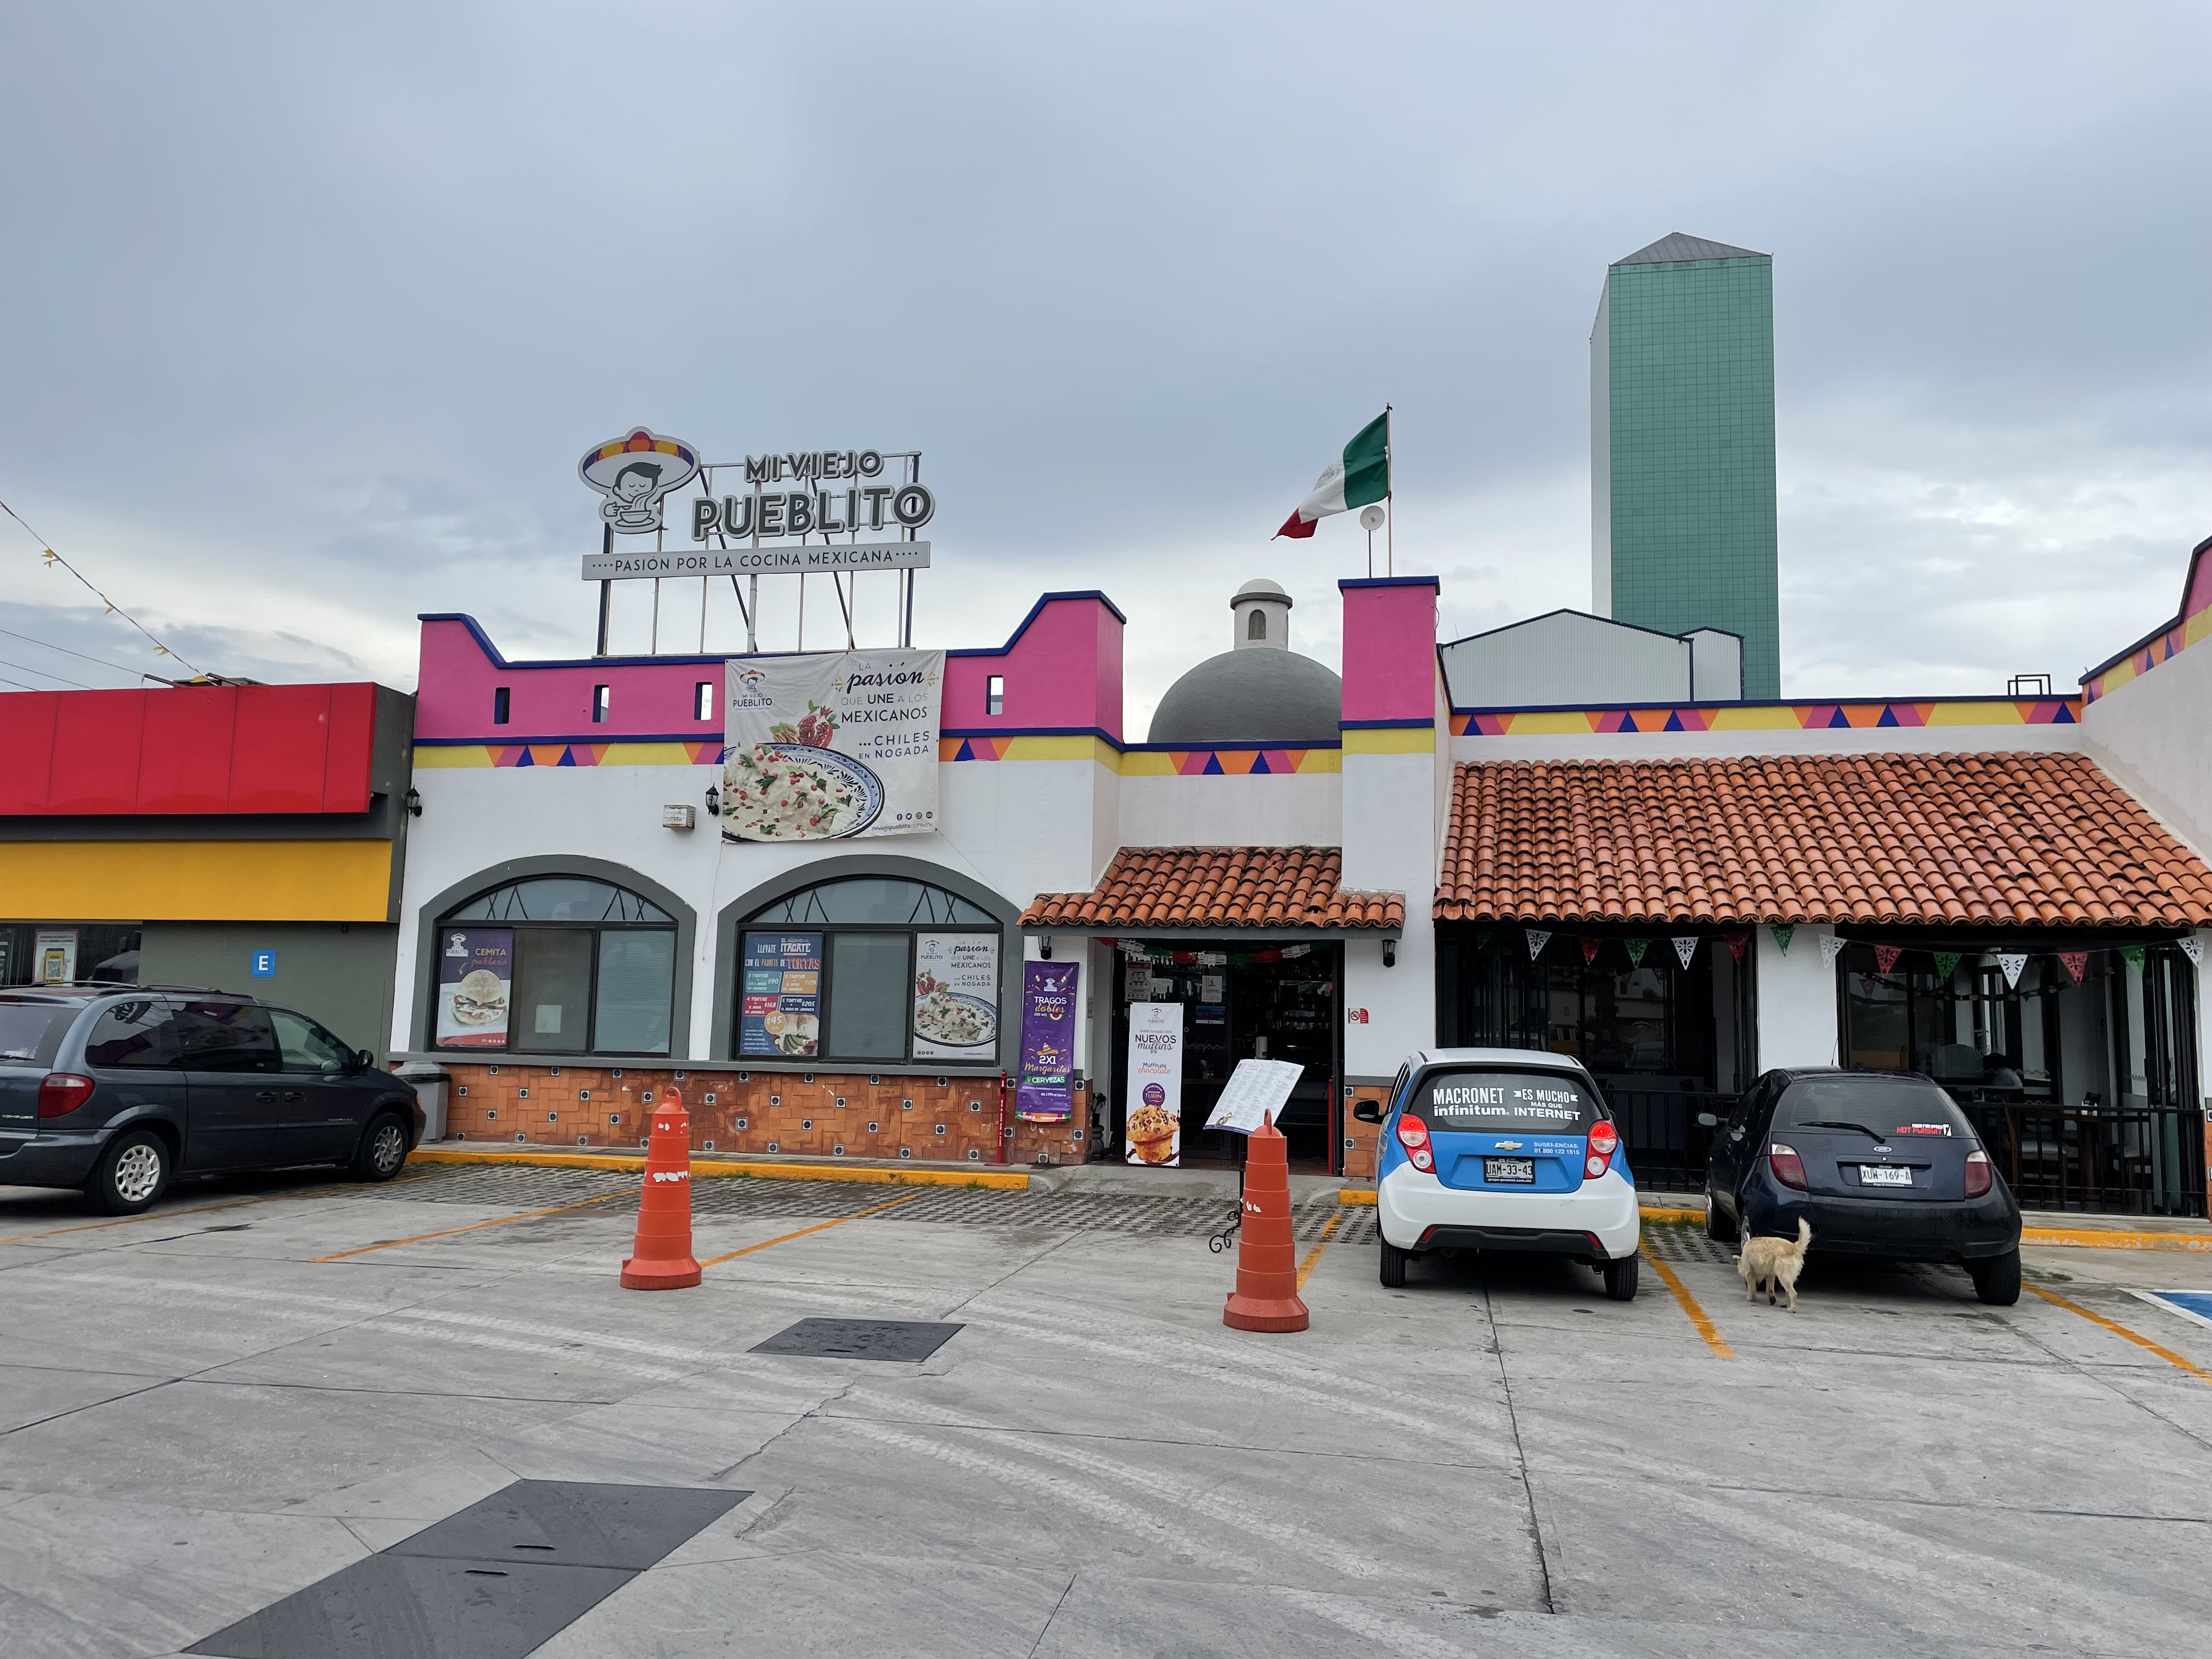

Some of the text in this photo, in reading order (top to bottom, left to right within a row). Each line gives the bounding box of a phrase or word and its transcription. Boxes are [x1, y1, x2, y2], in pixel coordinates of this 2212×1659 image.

[745, 449, 884, 483] MI VIEJO
[691, 483, 935, 541] PUEBLITO
[615, 549, 893, 572] PASIÓN POR LA COCINA MEXICANA
[859, 663, 872, 671] LA
[847, 662, 925, 694] pasión
[733, 698, 772, 708] PUEBLITO
[841, 697, 863, 706] QUE
[867, 693, 894, 704] UNE
[909, 693, 928, 702] LOS
[842, 707, 927, 723] MEXICANOS
[875, 744, 929, 759] NOGADA
[780, 943, 811, 952] ITACATE
[953, 941, 989, 955] pasión
[258, 955, 269, 971] E
[787, 958, 820, 969] TORTAS
[1034, 996, 1066, 1005] TRAGOS
[1035, 1002, 1065, 1013] dobles
[766, 1016, 782, 1025] $45
[1135, 1034, 1176, 1043] NUEVOS
[1137, 1040, 1174, 1053] muffins
[1024, 1062, 1071, 1075] Margaritas
[1433, 1088, 1504, 1105] MACRONET
[1522, 1088, 1570, 1103] ES MUCHO
[1514, 1107, 1581, 1121] INTERNET
[1486, 1164, 1533, 1175] UAM-33-43
